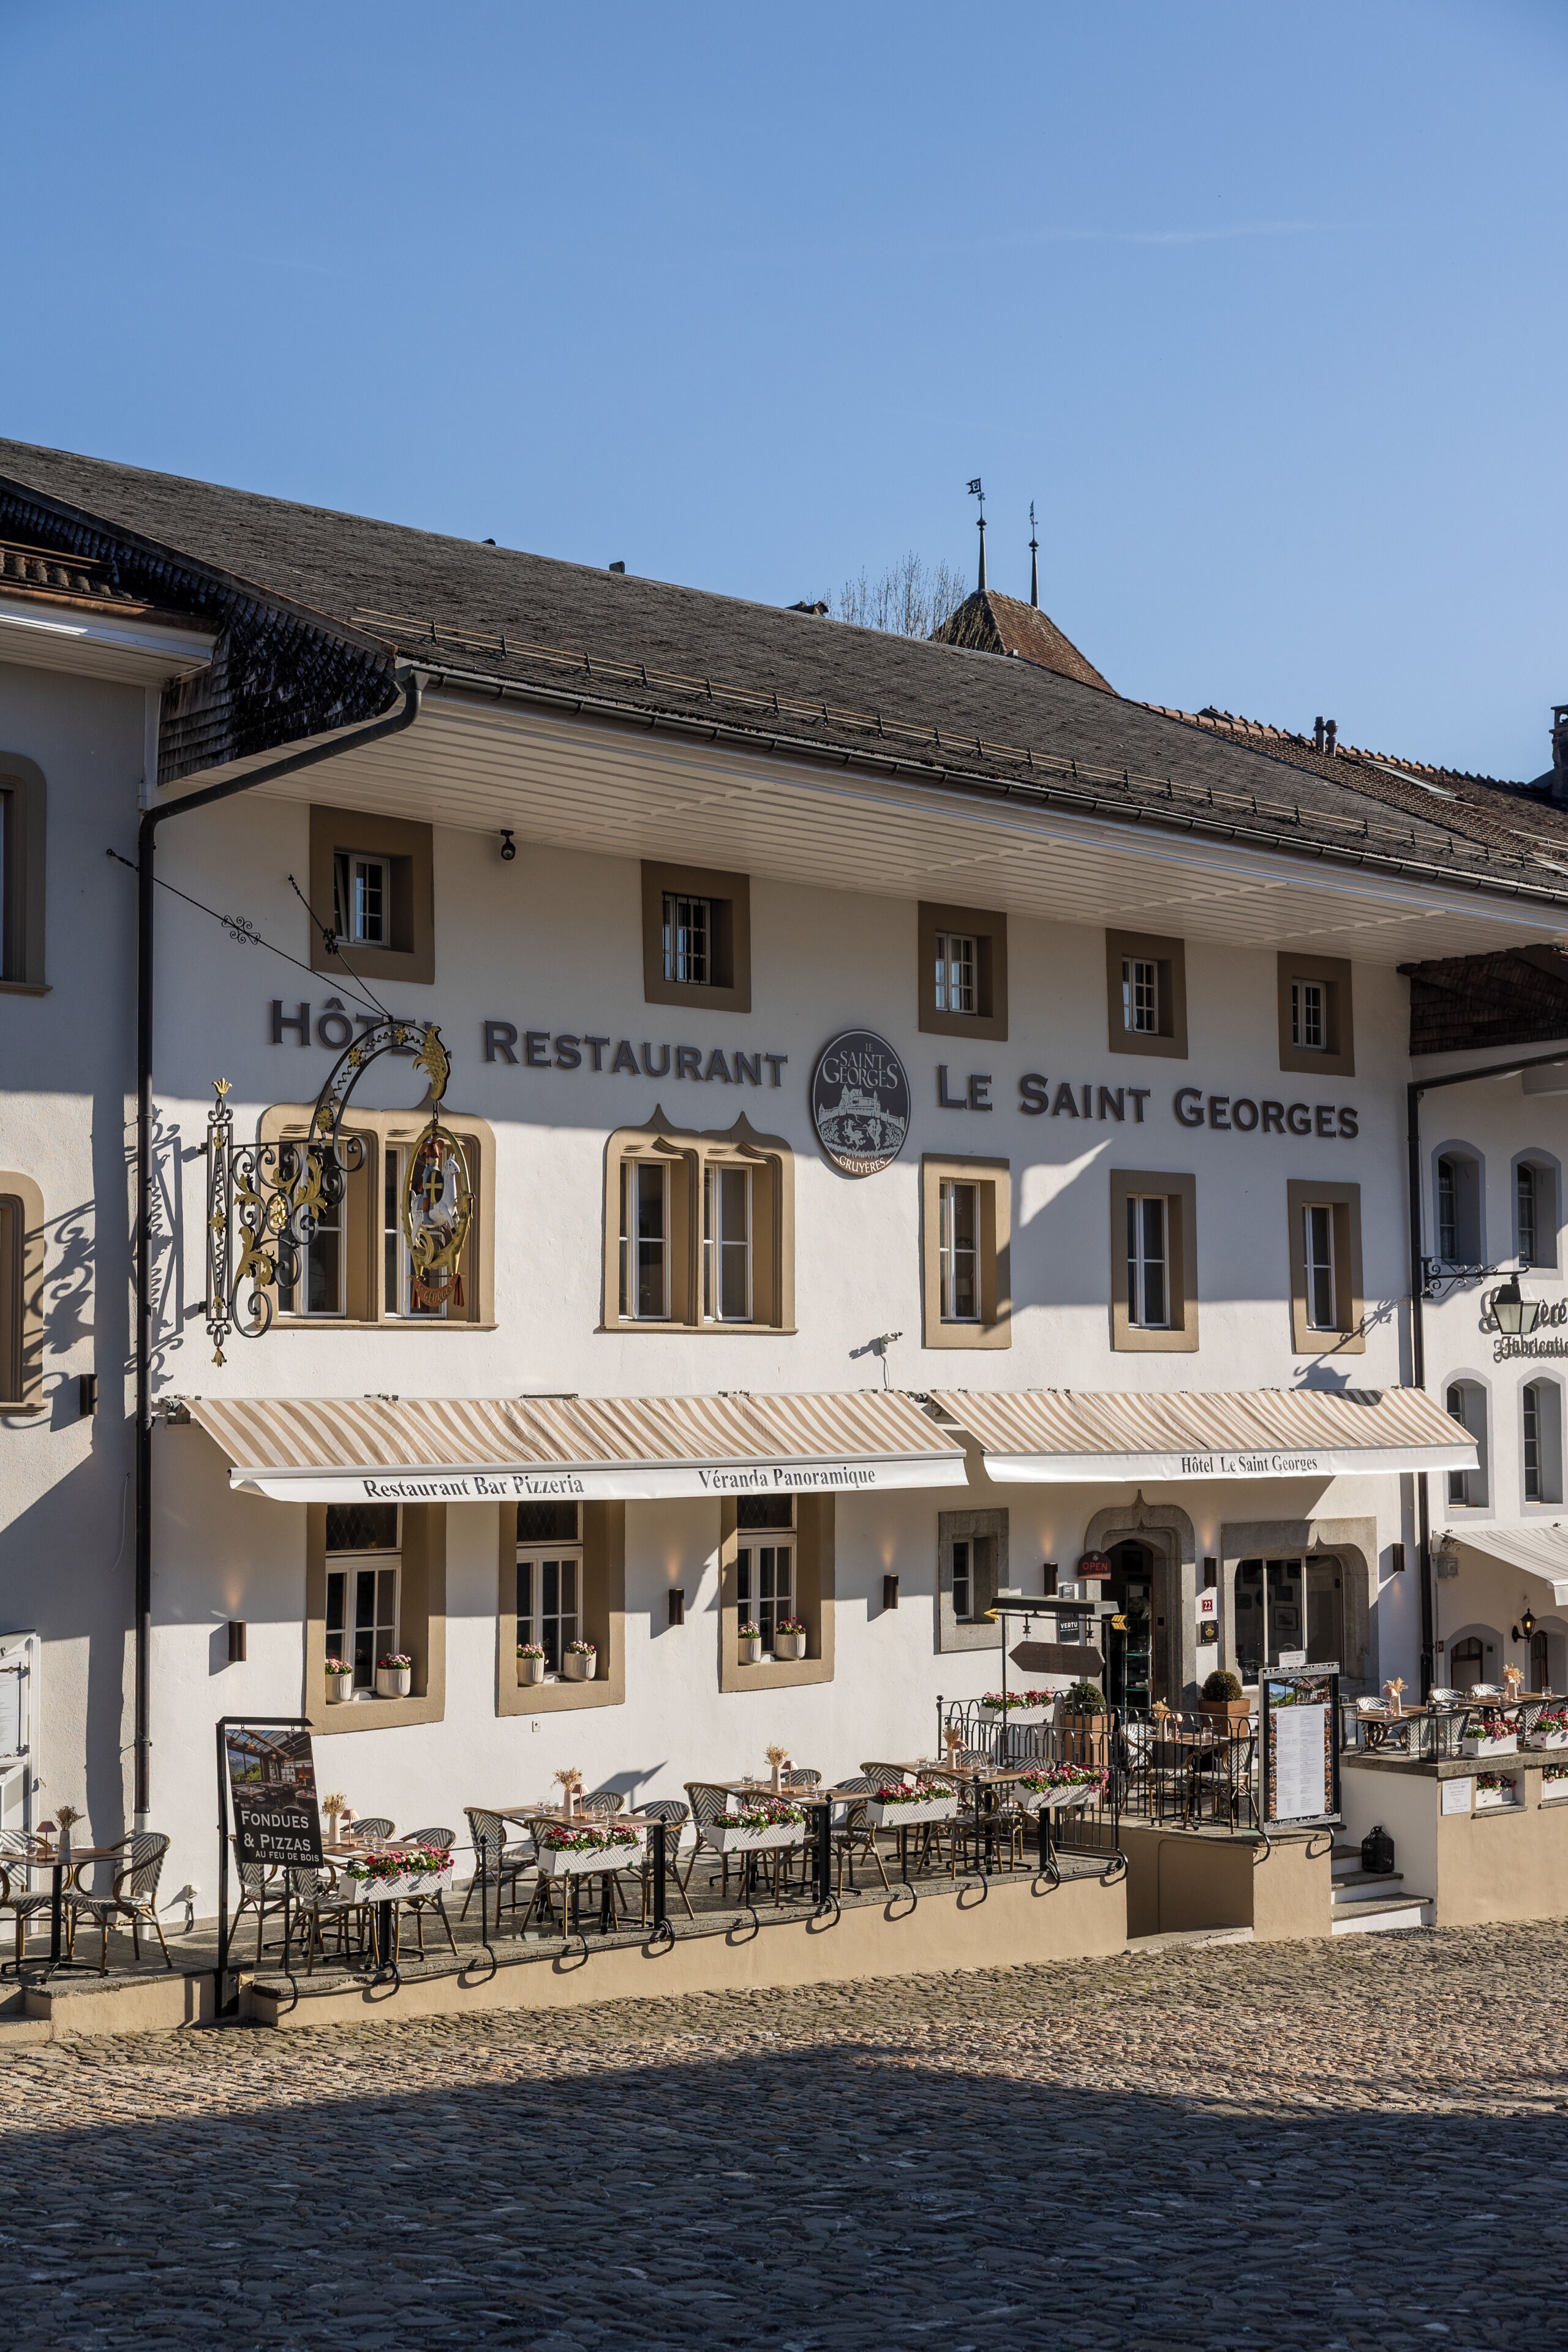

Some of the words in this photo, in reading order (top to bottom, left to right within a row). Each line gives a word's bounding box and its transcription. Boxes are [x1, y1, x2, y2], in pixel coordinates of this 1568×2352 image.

[272, 997, 451, 1058] HÔTE
[484, 1020, 788, 1087] RESTAURANT
[865, 1043, 873, 1052] LE
[840, 1050, 884, 1069] SAINT
[823, 1058, 898, 1089] GEORGES
[938, 1065, 993, 1111] LE
[1021, 1073, 1151, 1123] SAINT
[1175, 1088, 1359, 1139] GEORGES
[839, 1156, 886, 1174] GRUYÈRES
[1181, 1457, 1213, 1473] Hôtel
[1221, 1456, 1235, 1472] Le
[1238, 1456, 1268, 1471] Saint
[1272, 1455, 1317, 1471] Georges
[363, 1479, 470, 1498] Restaurant
[473, 1476, 507, 1495] Bar
[511, 1474, 584, 1494] Pizzeria
[698, 1469, 769, 1489] Véranda
[772, 1466, 876, 1488] Panoramique
[1083, 1562, 1107, 1571] OPEN
[1204, 1601, 1212, 1610] 22
[241, 1811, 309, 1828] FONDUES
[244, 1833, 254, 1848] &
[260, 1834, 311, 1852] PIZZAS
[288, 1852, 298, 1861] DE
[301, 1853, 319, 1862] BOIS
